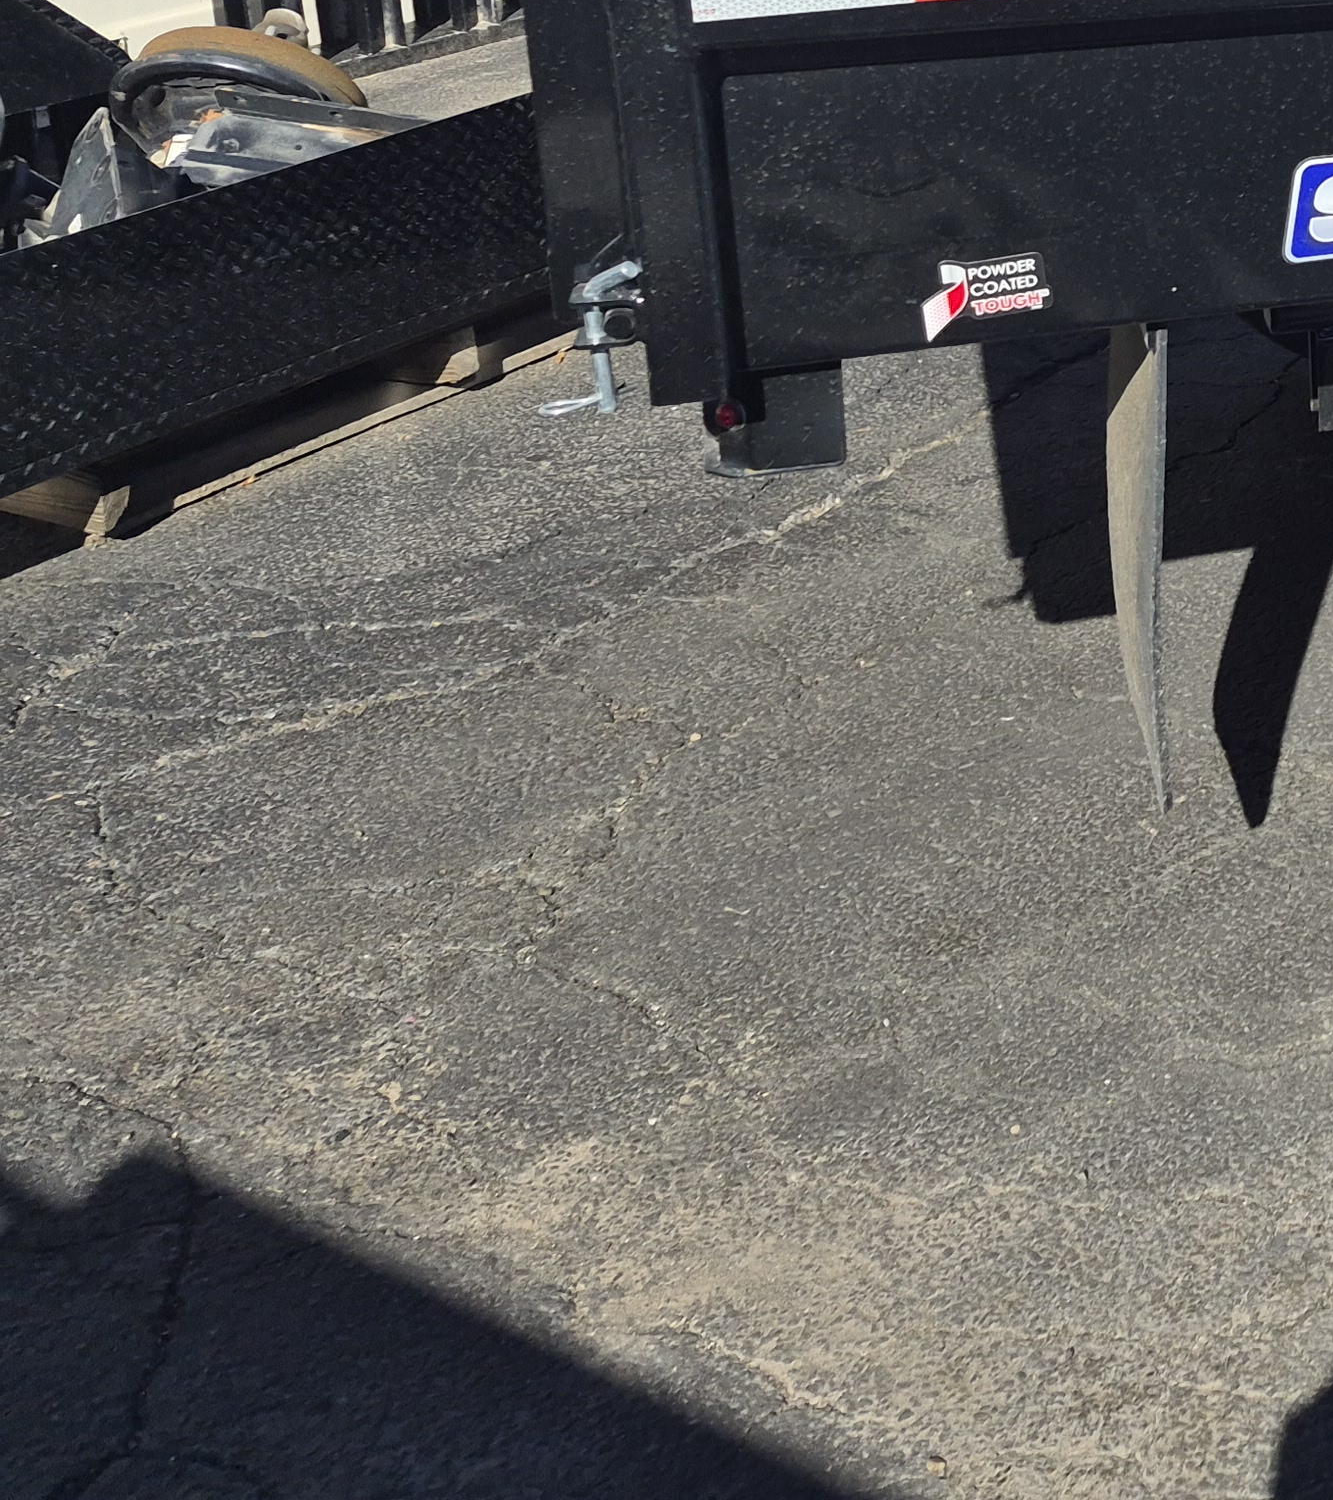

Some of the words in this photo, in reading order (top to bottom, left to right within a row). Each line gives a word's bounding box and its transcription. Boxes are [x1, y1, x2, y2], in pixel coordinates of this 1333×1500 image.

[967, 258, 1036, 281] POWDER
[969, 274, 1038, 297] COATED
[971, 291, 1042, 316] TOUGH
